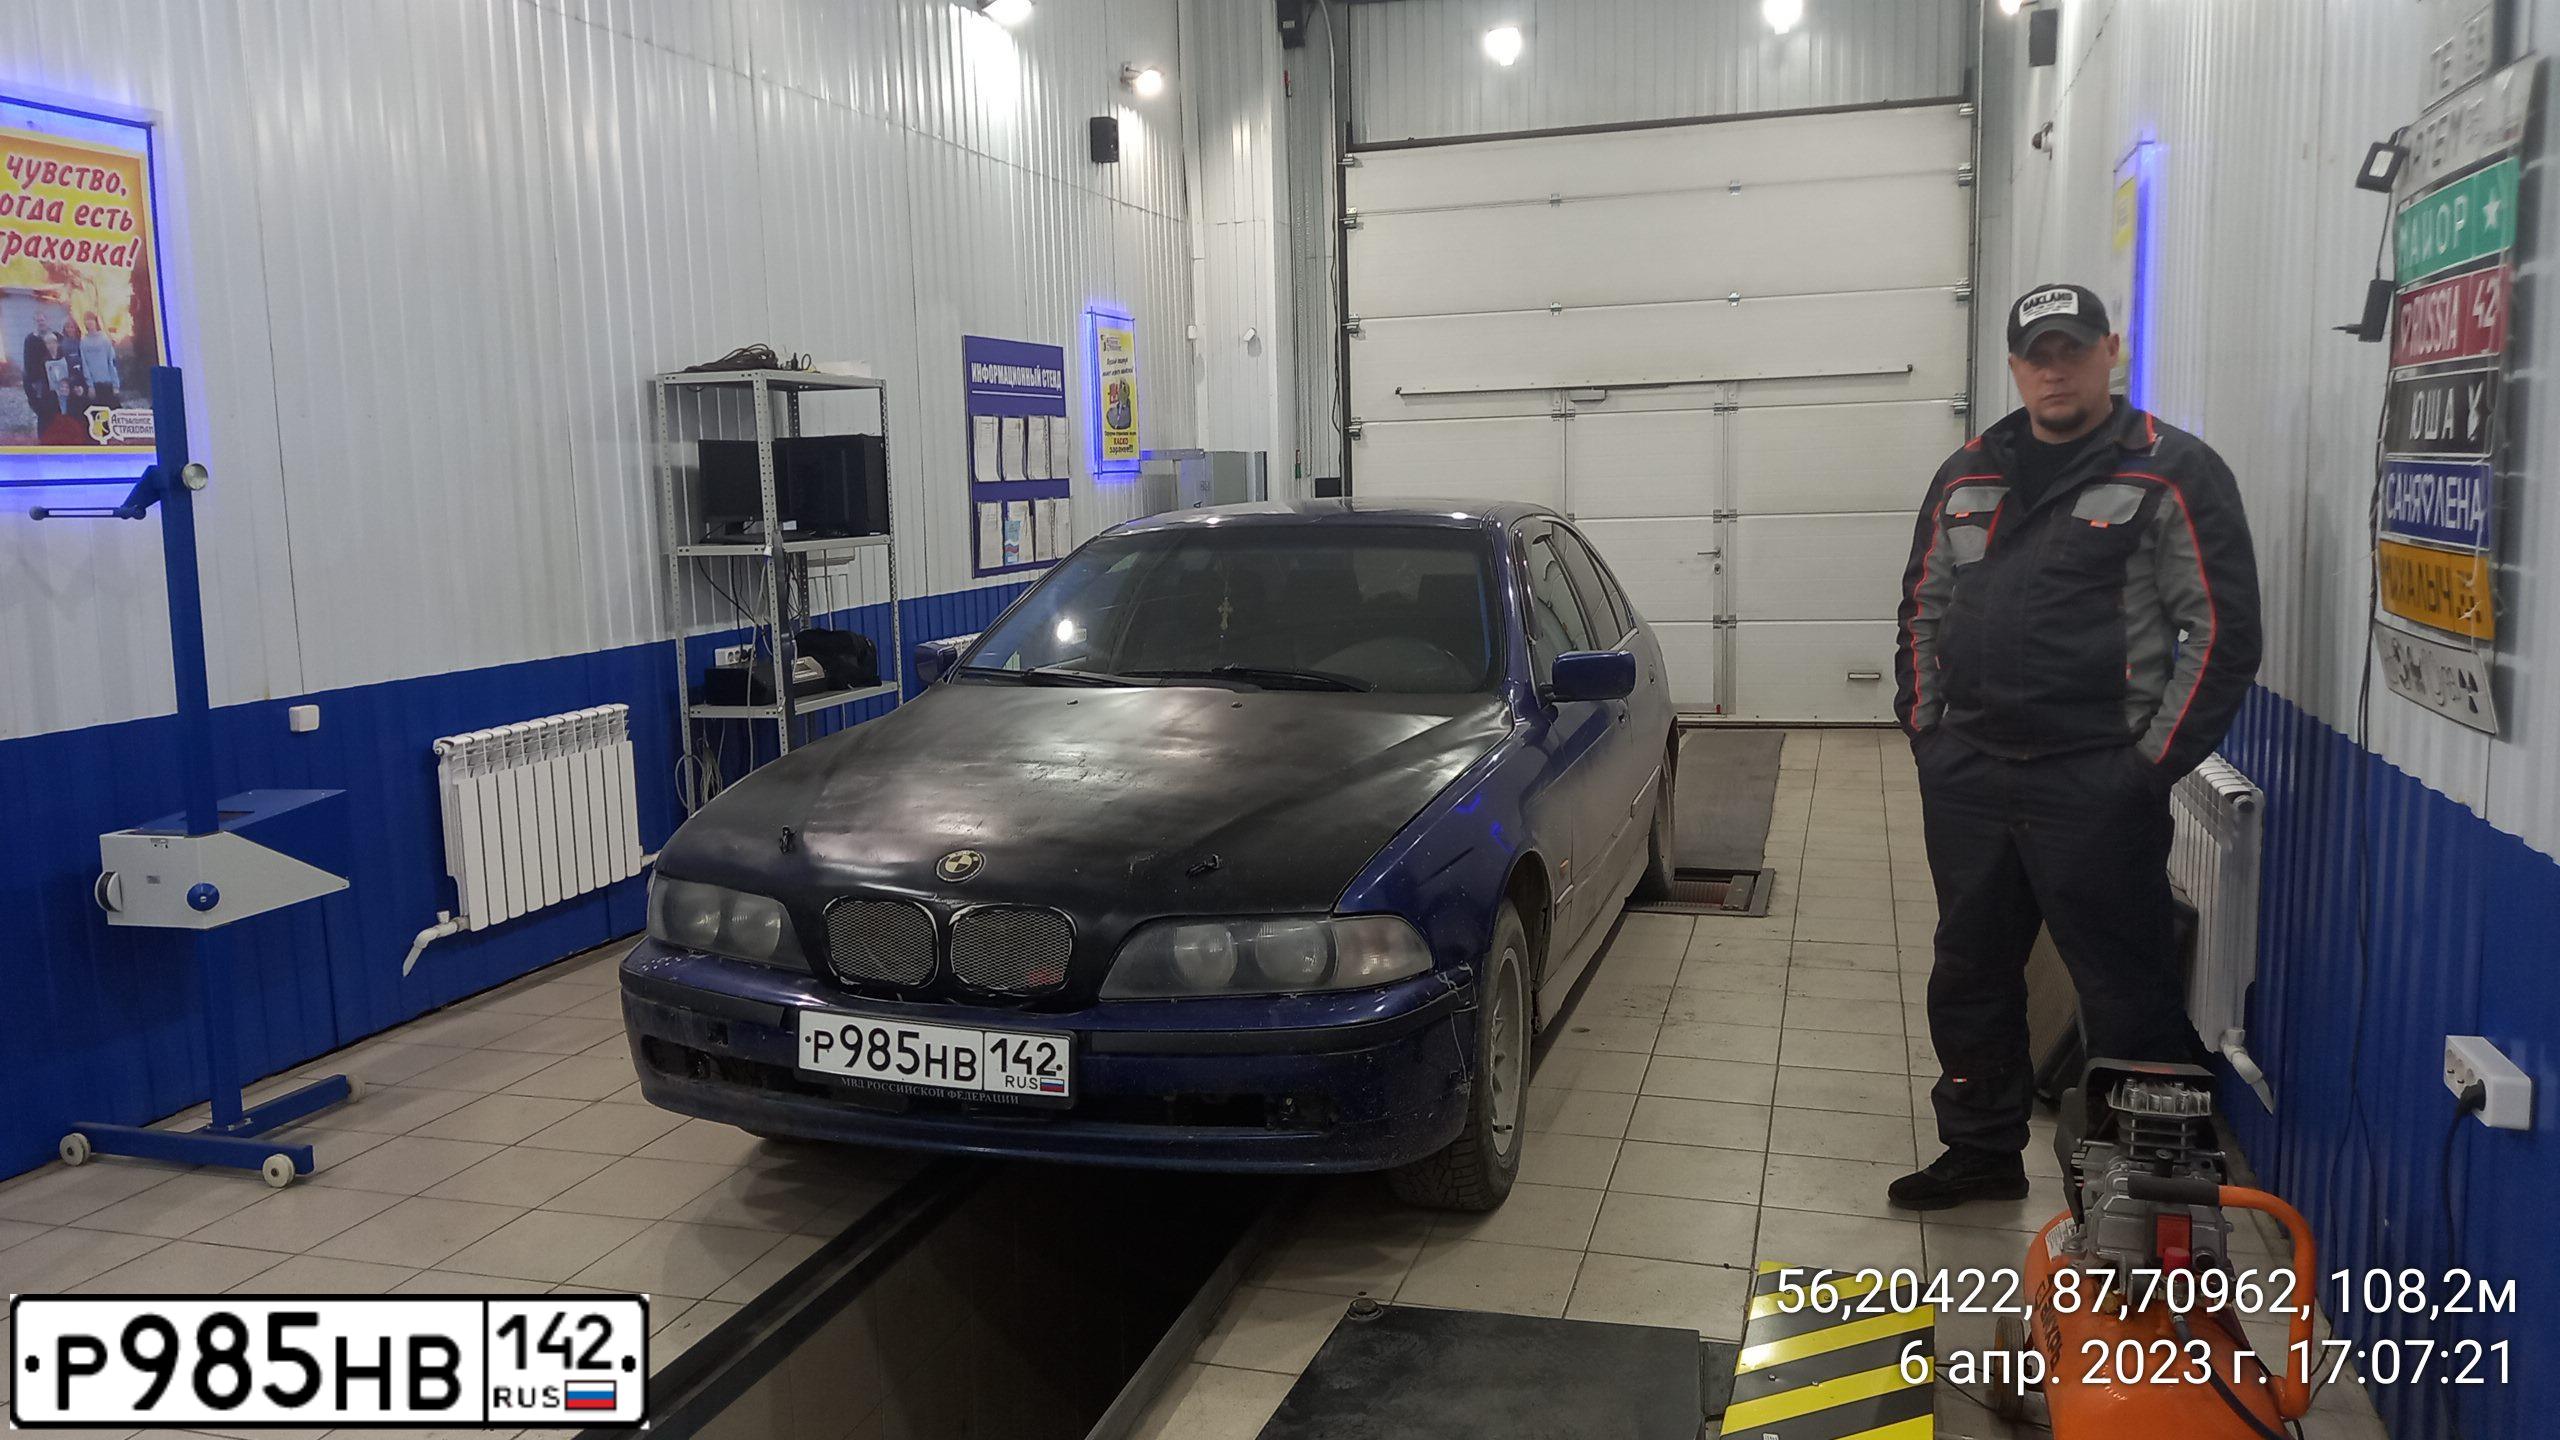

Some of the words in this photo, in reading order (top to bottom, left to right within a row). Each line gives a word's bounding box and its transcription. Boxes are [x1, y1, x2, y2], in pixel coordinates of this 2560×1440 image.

[6, 154, 127, 196] чувство,
[0, 193, 64, 223] огда
[74, 204, 133, 231] есть
[971, 362, 1041, 388] ИНФОРМАЦИОННЫЙ
[1041, 368, 1062, 392] СТЕНД
[813, 1024, 977, 1082] Р985НВ
[990, 1038, 1057, 1076] 142
[842, 1077, 865, 1088] МВД
[866, 1080, 945, 1099] РОССИЙСКОЙ
[947, 1090, 1020, 1105] ФЕДЕРАЦИИ
[1005, 1074, 1038, 1090] RUS
